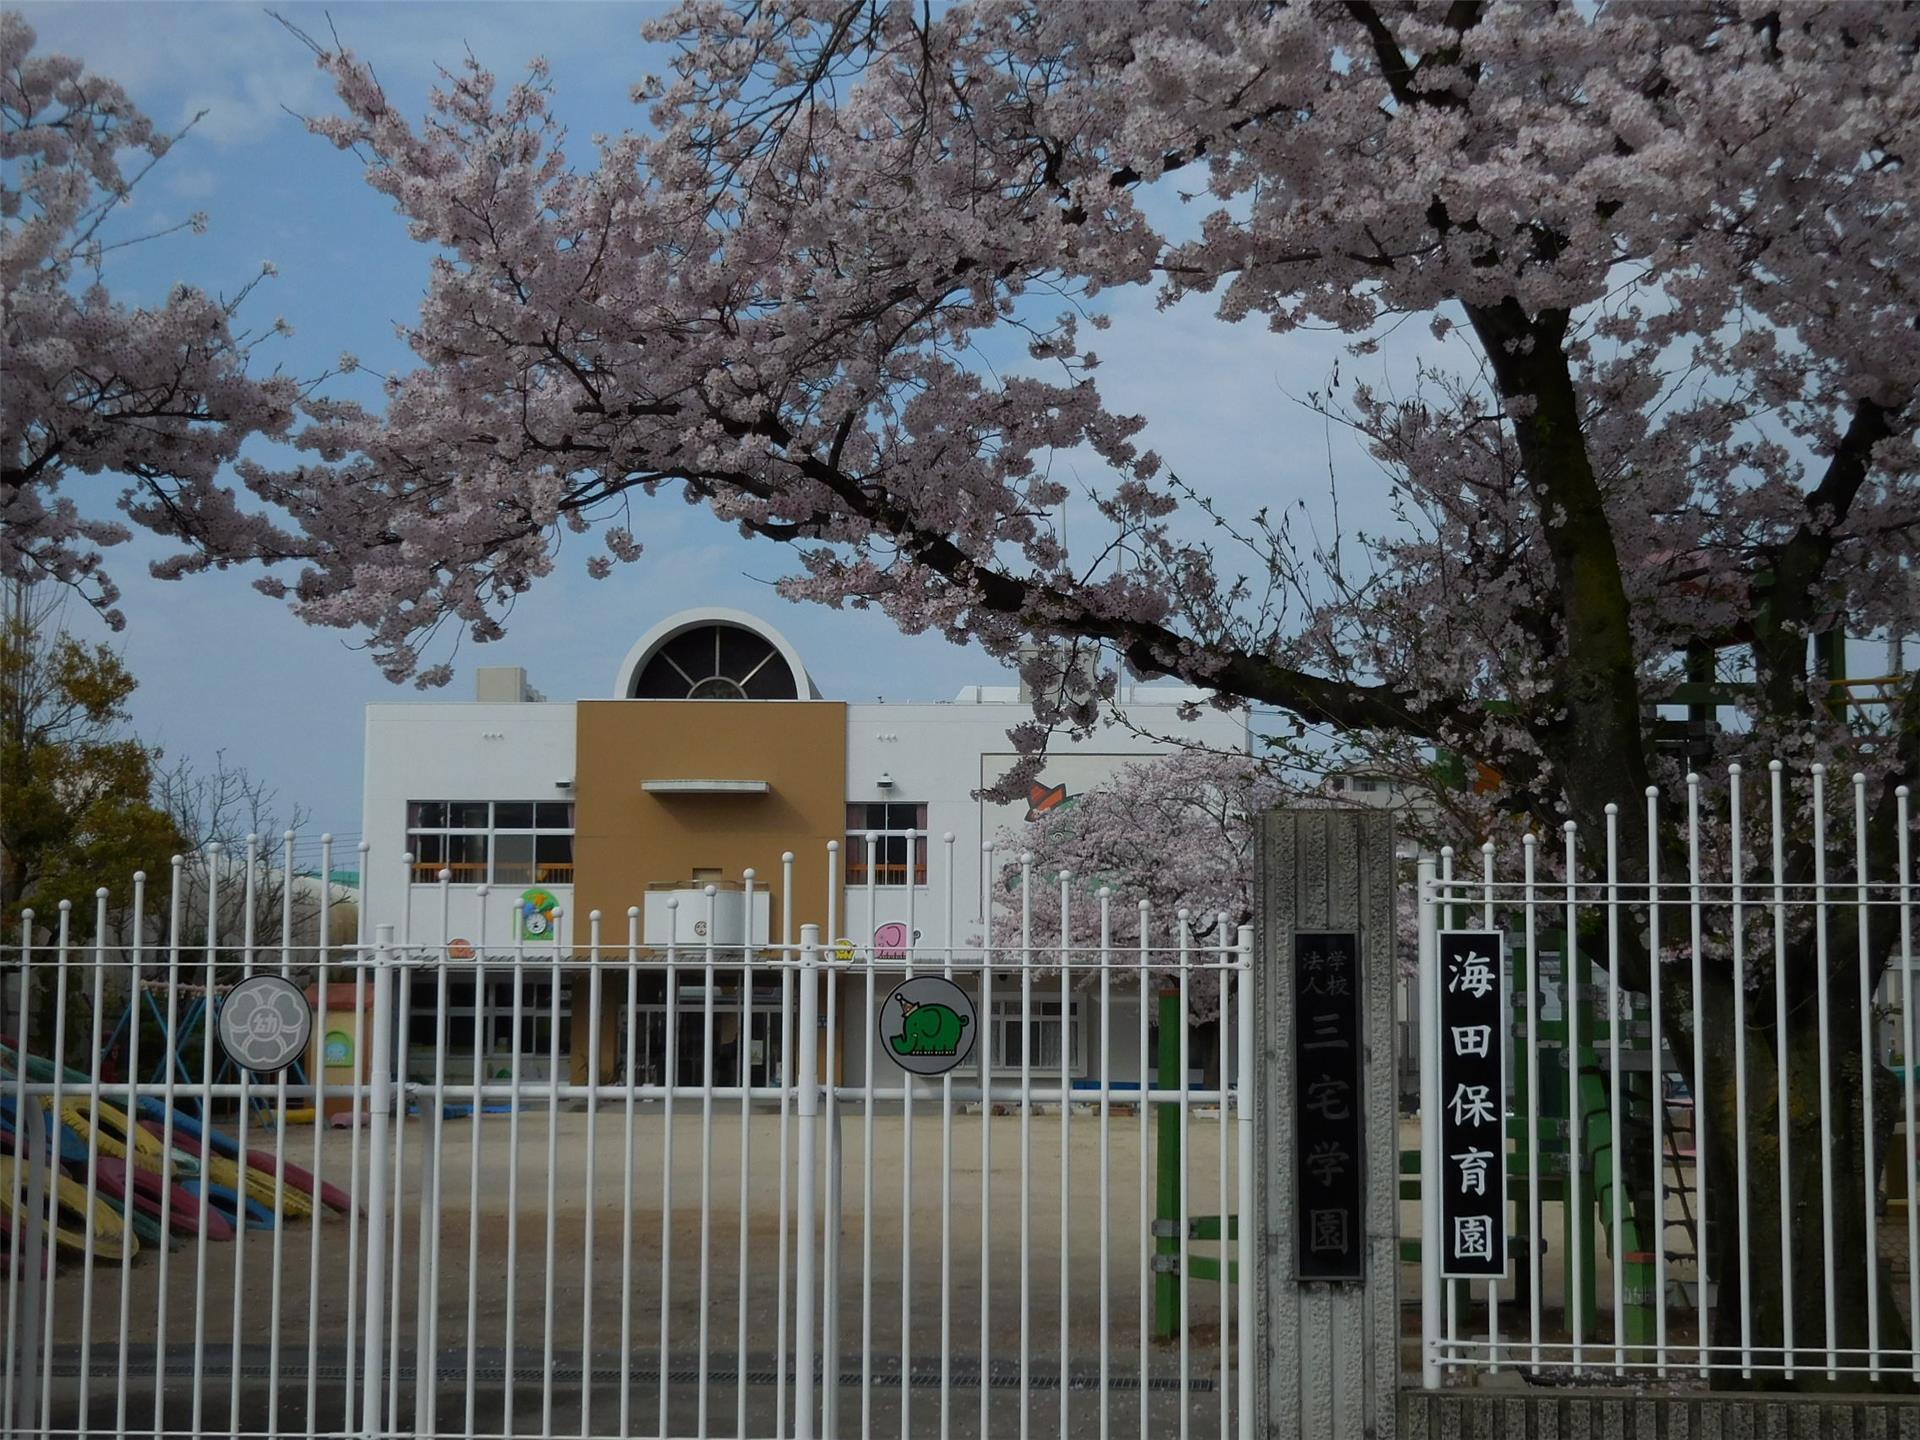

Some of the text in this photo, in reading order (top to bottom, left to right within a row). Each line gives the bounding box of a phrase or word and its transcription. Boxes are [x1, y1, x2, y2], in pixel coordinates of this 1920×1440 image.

[1303, 1012, 1349, 1256] 三宅学園
[1447, 951, 1498, 1263] 海田保育園
